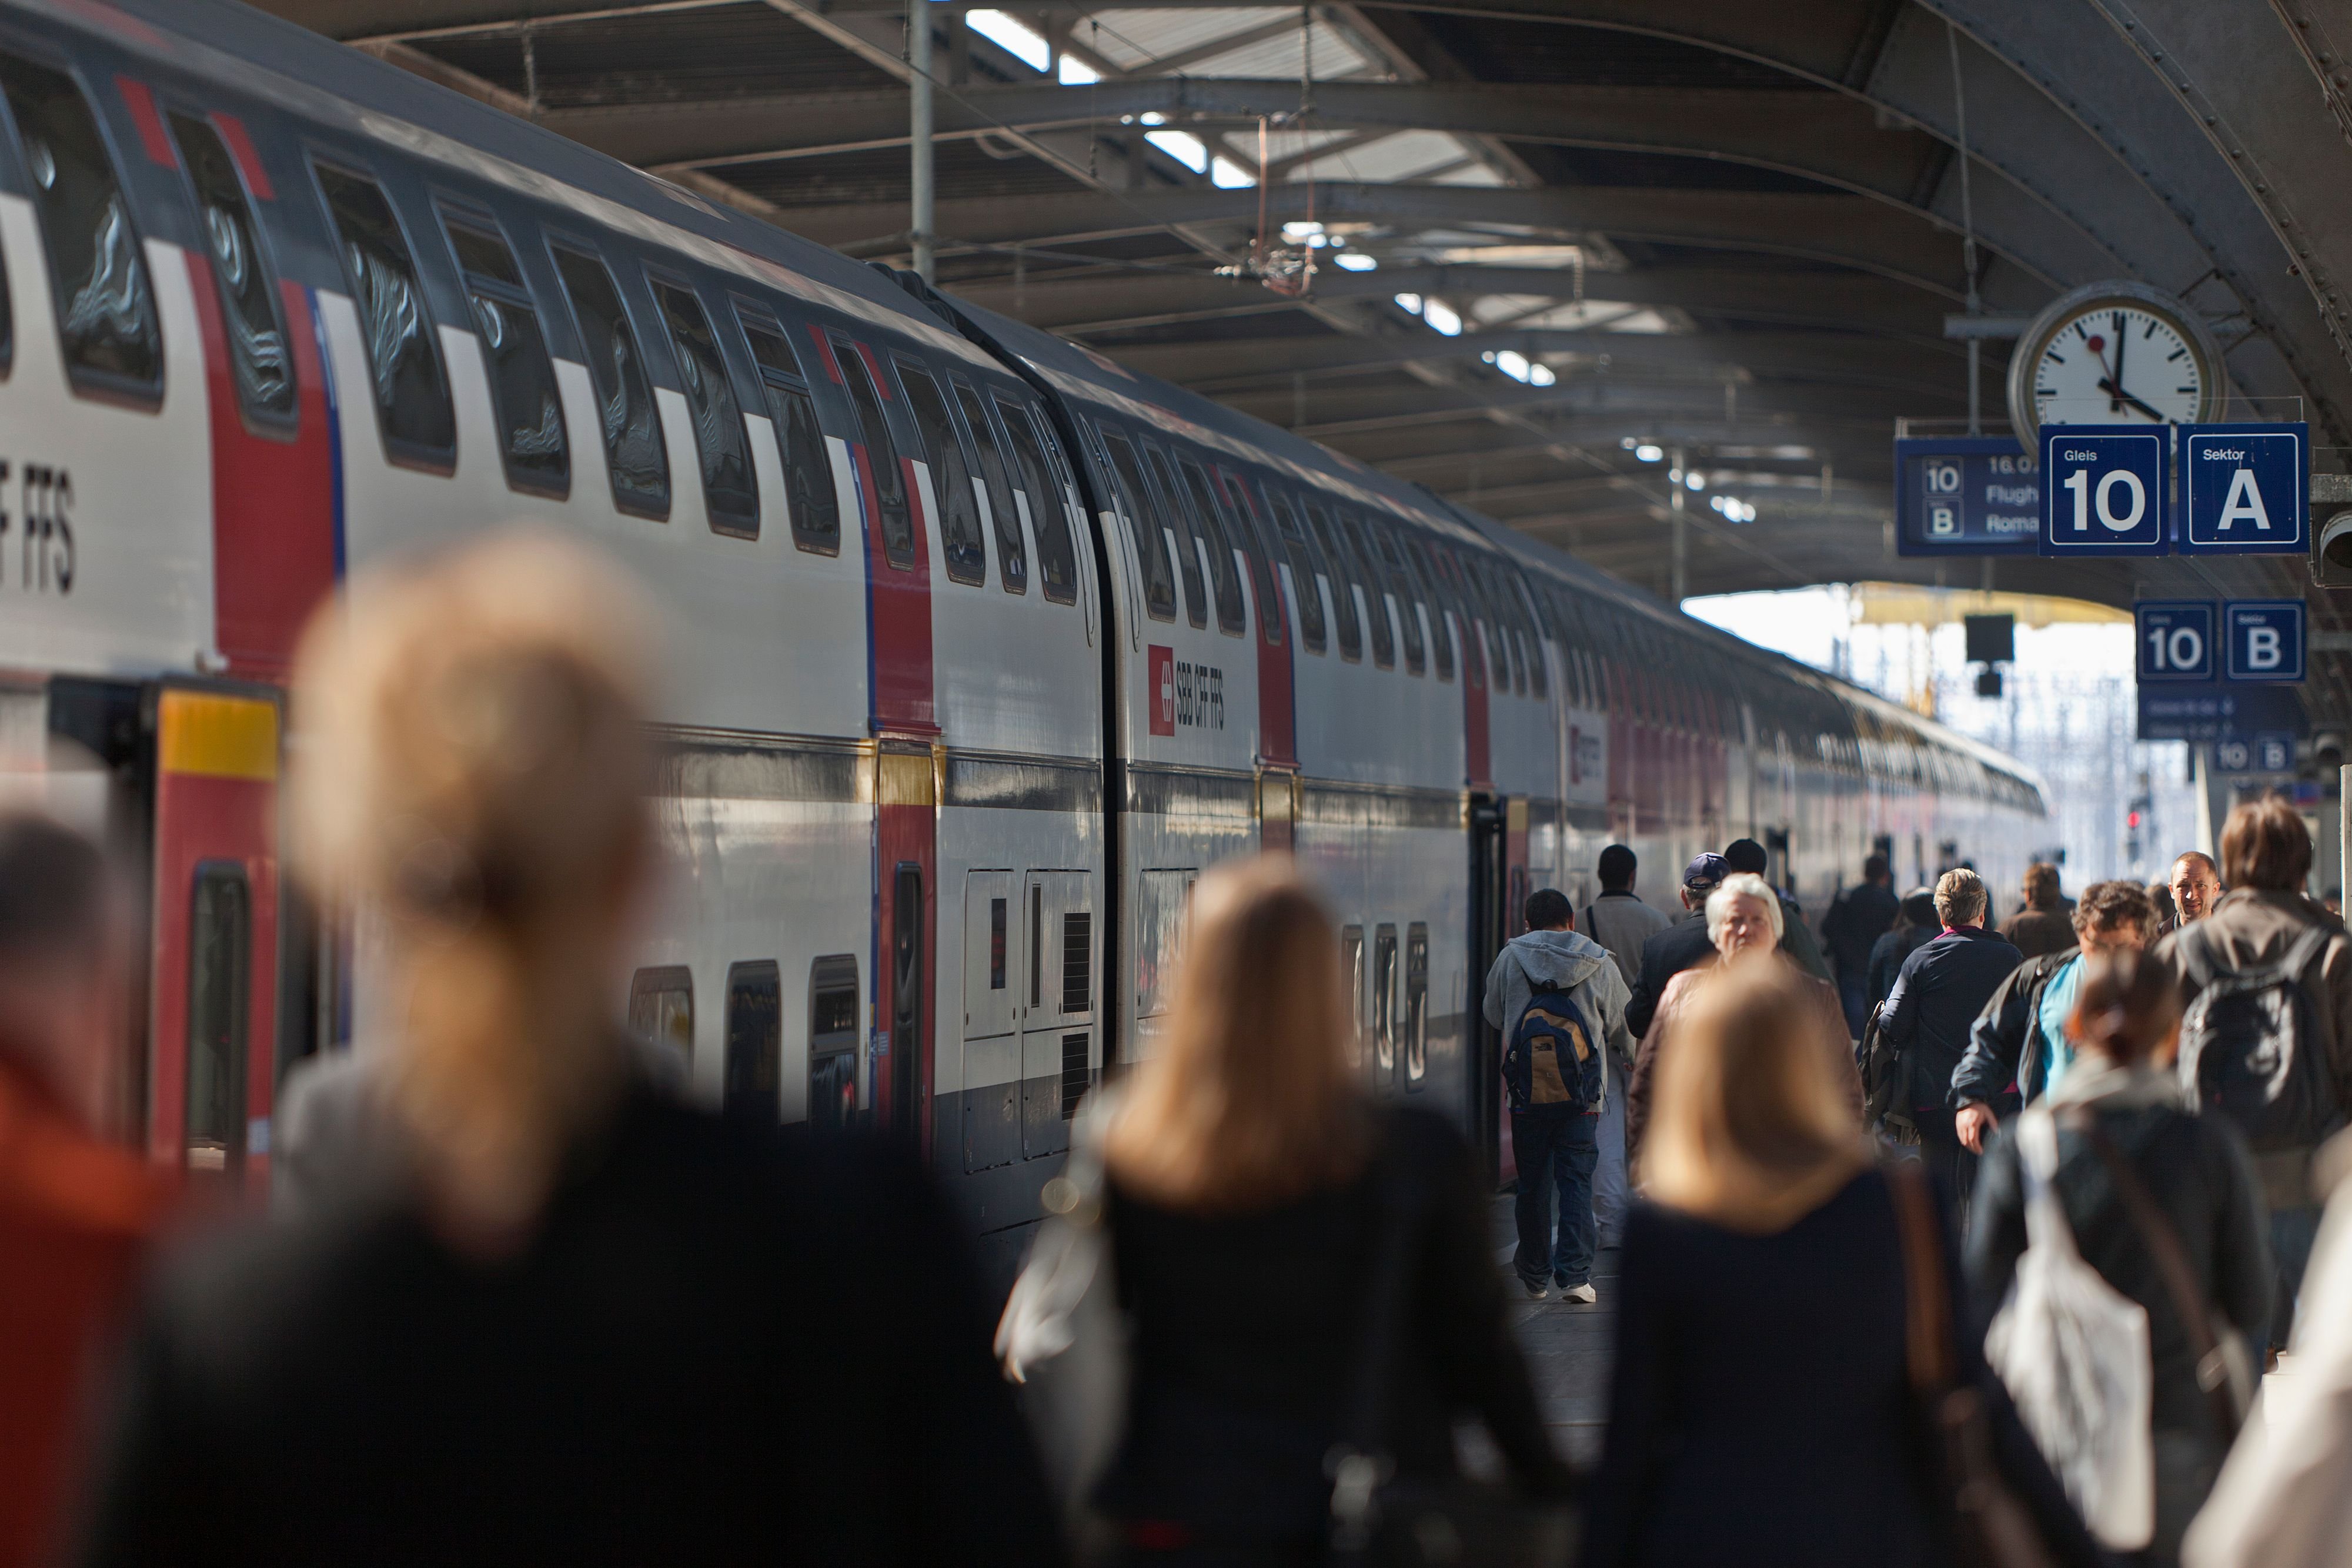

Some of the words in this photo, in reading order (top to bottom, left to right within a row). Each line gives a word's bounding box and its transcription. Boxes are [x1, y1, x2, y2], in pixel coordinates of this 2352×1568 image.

[1990, 455, 2039, 474] 16.0
[2064, 450, 2097, 462] Gleis
[2203, 449, 2246, 461] Sektor
[1928, 467, 1960, 492] 10
[2064, 469, 2146, 531] 10
[2217, 469, 2271, 529] A
[22, 463, 76, 596] FFS
[1933, 508, 1954, 534] B
[2148, 627, 2203, 670] 10
[2248, 627, 2282, 669] B
[1177, 661, 1192, 726] SBB
[1195, 663, 1208, 728] CFF
[1210, 667, 1224, 731] FFS
